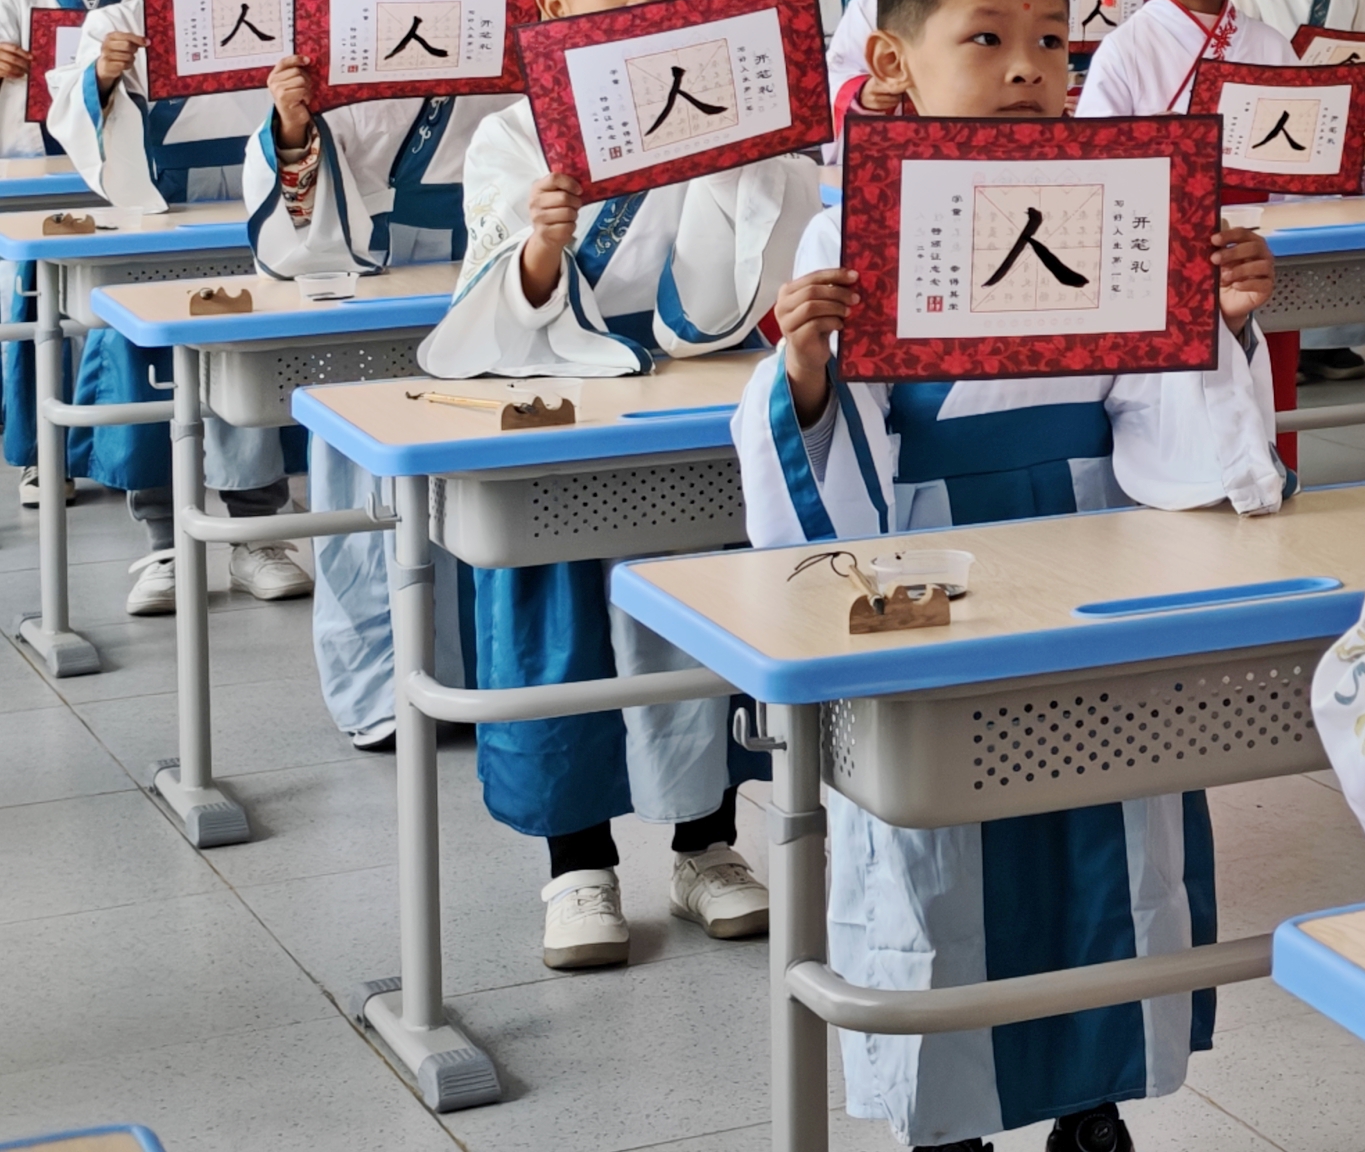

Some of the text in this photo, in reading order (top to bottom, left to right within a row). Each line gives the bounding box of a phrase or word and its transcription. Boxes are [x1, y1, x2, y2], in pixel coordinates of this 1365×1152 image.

[221, 4, 275, 46] 人
[385, 16, 448, 60] 人
[646, 66, 727, 135] 人
[1252, 111, 1305, 150] 人
[983, 207, 1089, 287] 人
[1130, 216, 1151, 274] 开笔礼
